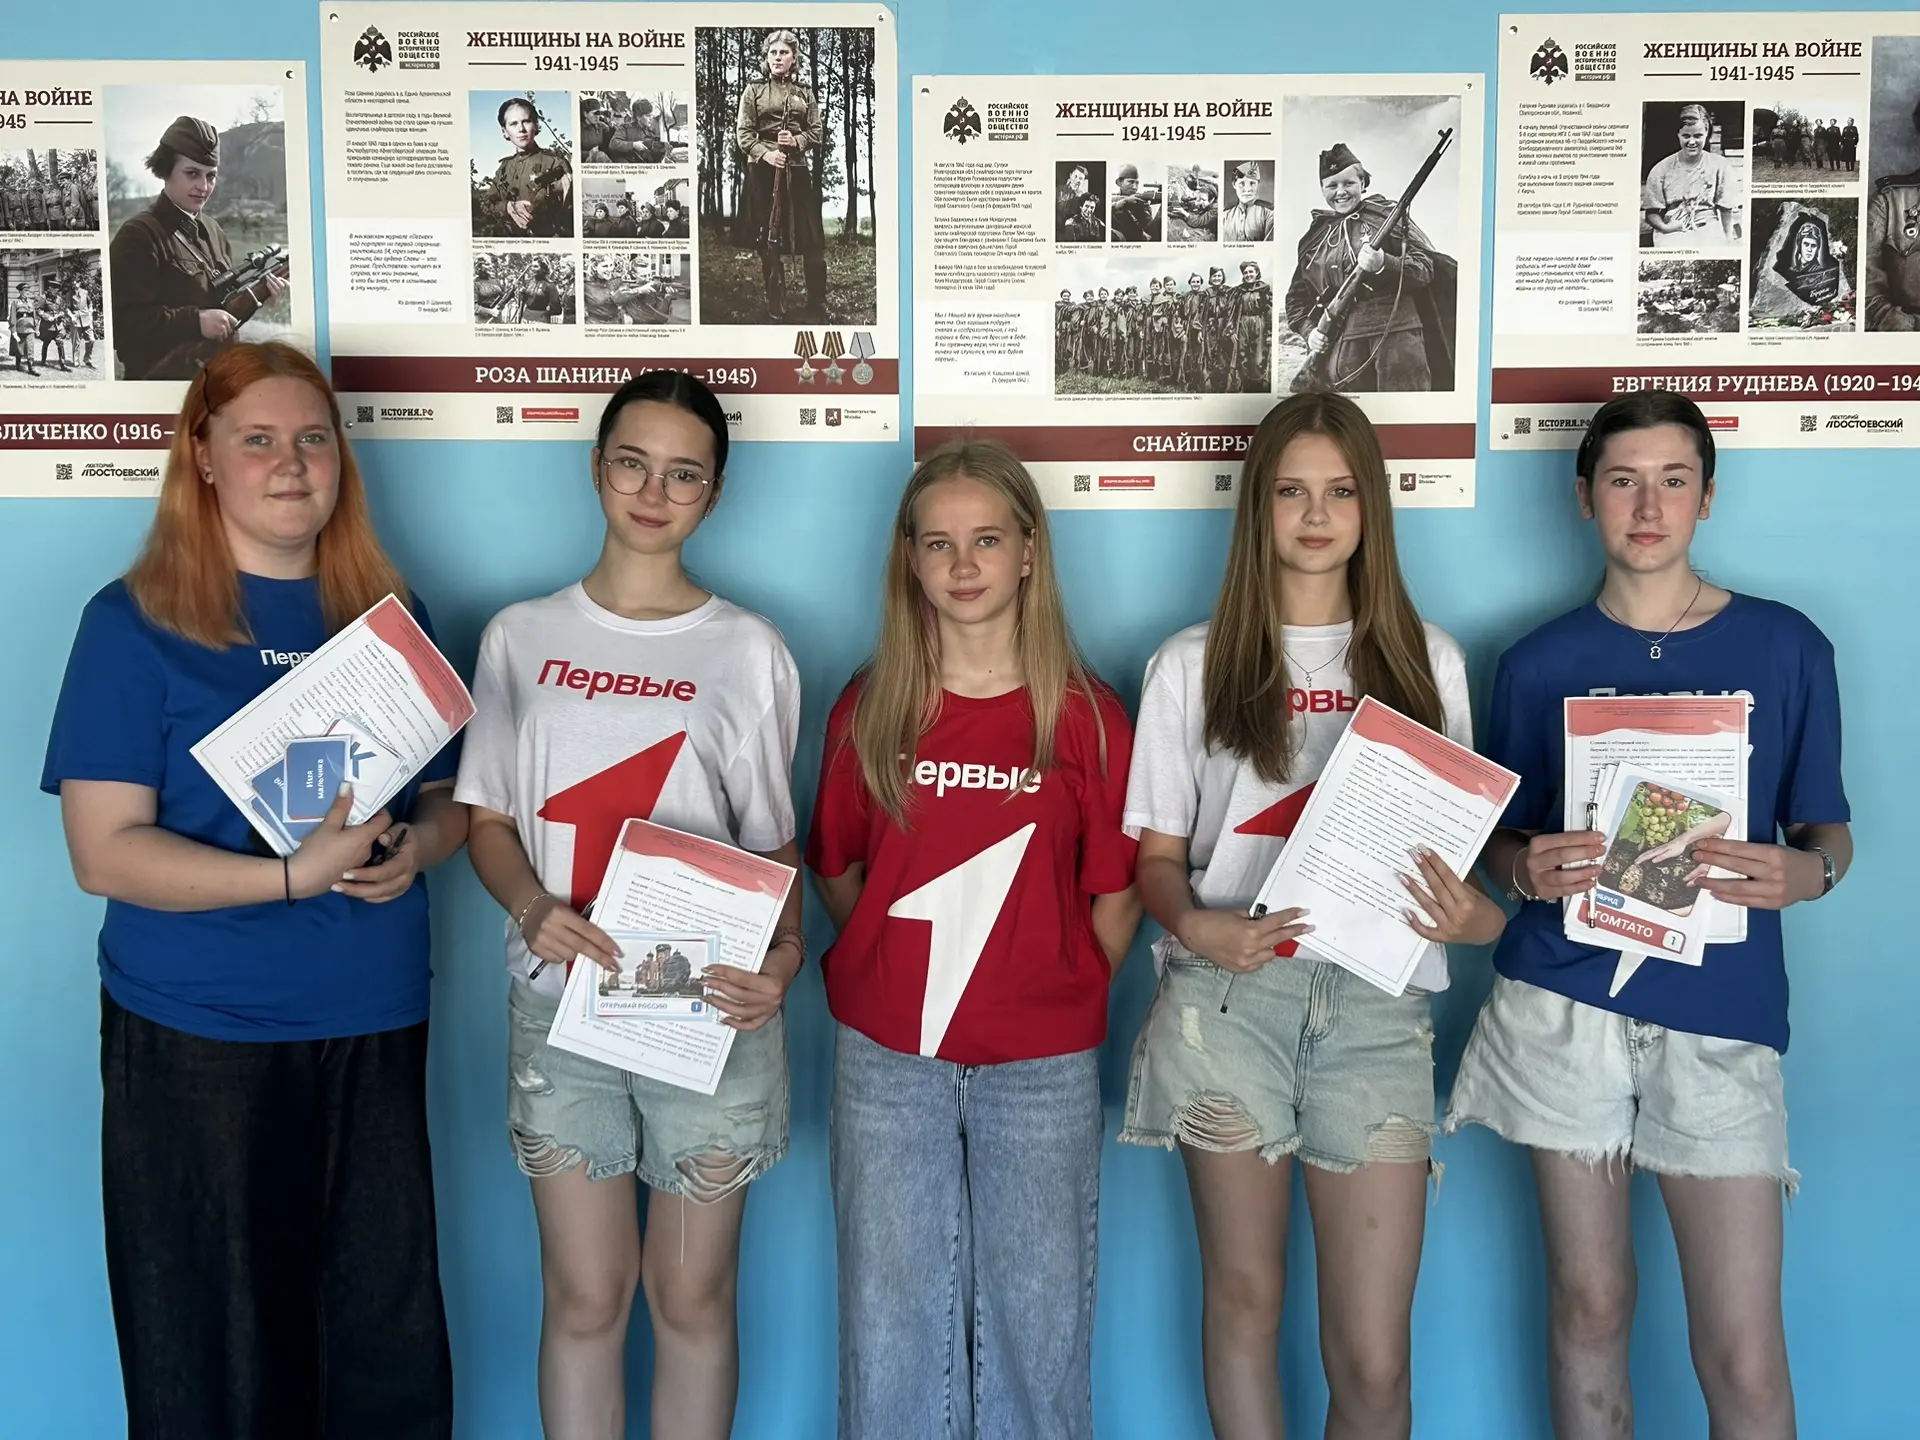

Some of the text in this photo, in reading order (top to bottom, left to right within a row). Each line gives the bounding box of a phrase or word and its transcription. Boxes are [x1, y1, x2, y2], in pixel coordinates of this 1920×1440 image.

[466, 29, 685, 50] ЖЕНЩИНЫ НА ВОЙНЕ
[1643, 39, 1862, 60] ЖЕНЩИНЫ НА ВОЙНЕ
[534, 56, 618, 71] 1941-1945
[1710, 66, 1794, 81] 1941-1945
[25, 87, 92, 105] ВОЙНЕ
[1056, 99, 1272, 120] ЖЕНЩИНЫ НА ВОЙНЕ
[1122, 126, 1206, 141] 1941-1945
[475, 367, 530, 384] РОЗА
[536, 367, 632, 384] ШАНИНА
[1612, 376, 1712, 392] ЕВГЕНИЯ
[1717, 375, 1818, 395] РУДНЕВА
[381, 408, 434, 416] ИСТОРИЯ.РФ
[0, 424, 107, 440] ЛИЧЕНКО
[1133, 432, 1253, 452] СНАЙПЕРЫ
[537, 660, 697, 701] Первые
[899, 754, 1042, 797] ервые
